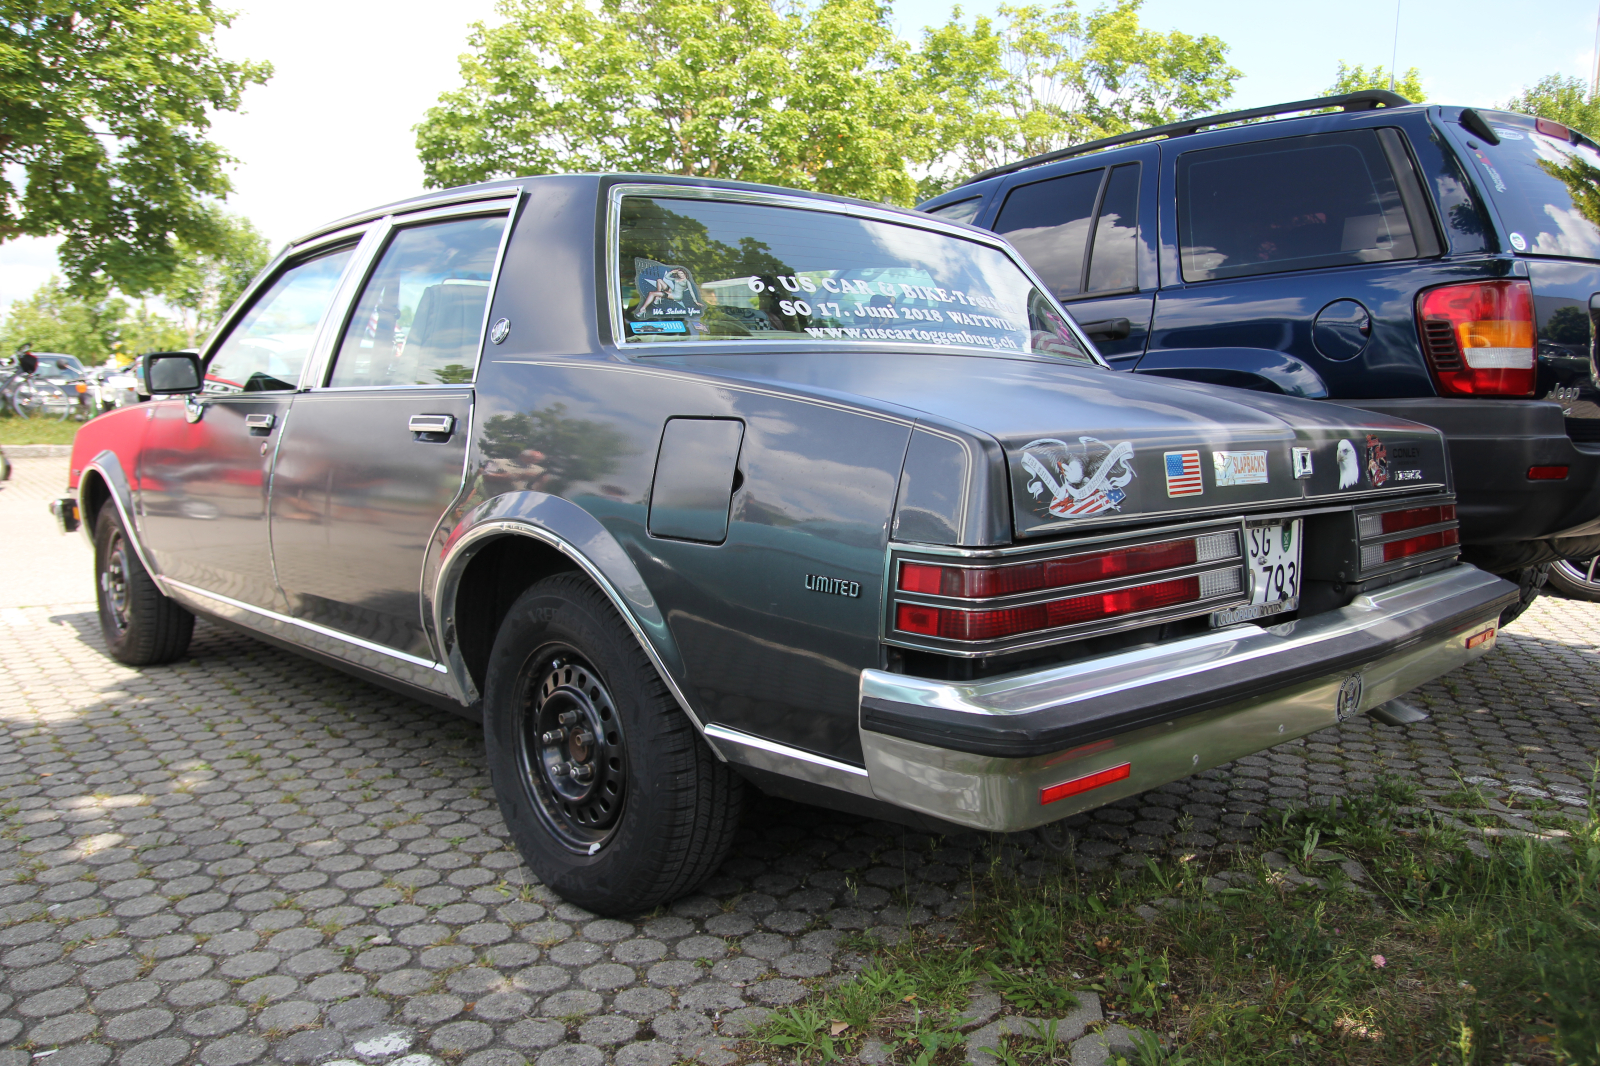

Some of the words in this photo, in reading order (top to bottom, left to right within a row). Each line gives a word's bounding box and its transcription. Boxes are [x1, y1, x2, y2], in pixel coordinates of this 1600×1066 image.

[747, 275, 775, 293] 6.
[777, 275, 817, 293] US
[821, 277, 876, 296] CAR
[878, 281, 897, 297] &
[897, 283, 1018, 315] BIKE-Treffen
[687, 307, 701, 317] You
[779, 300, 812, 317] SO
[816, 302, 851, 318] 17.
[853, 302, 900, 319] Juni
[900, 307, 944, 323] 2018
[945, 310, 1017, 332] WATTWIL
[803, 327, 1018, 350] www.uscartoggenburg.ch
[1547, 382, 1580, 403] Jeep
[1392, 446, 1422, 459] CONLEY
[1232, 455, 1266, 475] SLAPBACKS
[1250, 527, 1271, 558] SG
[804, 573, 862, 599] LIMITED
[1220, 606, 1258, 625] COLORADO
